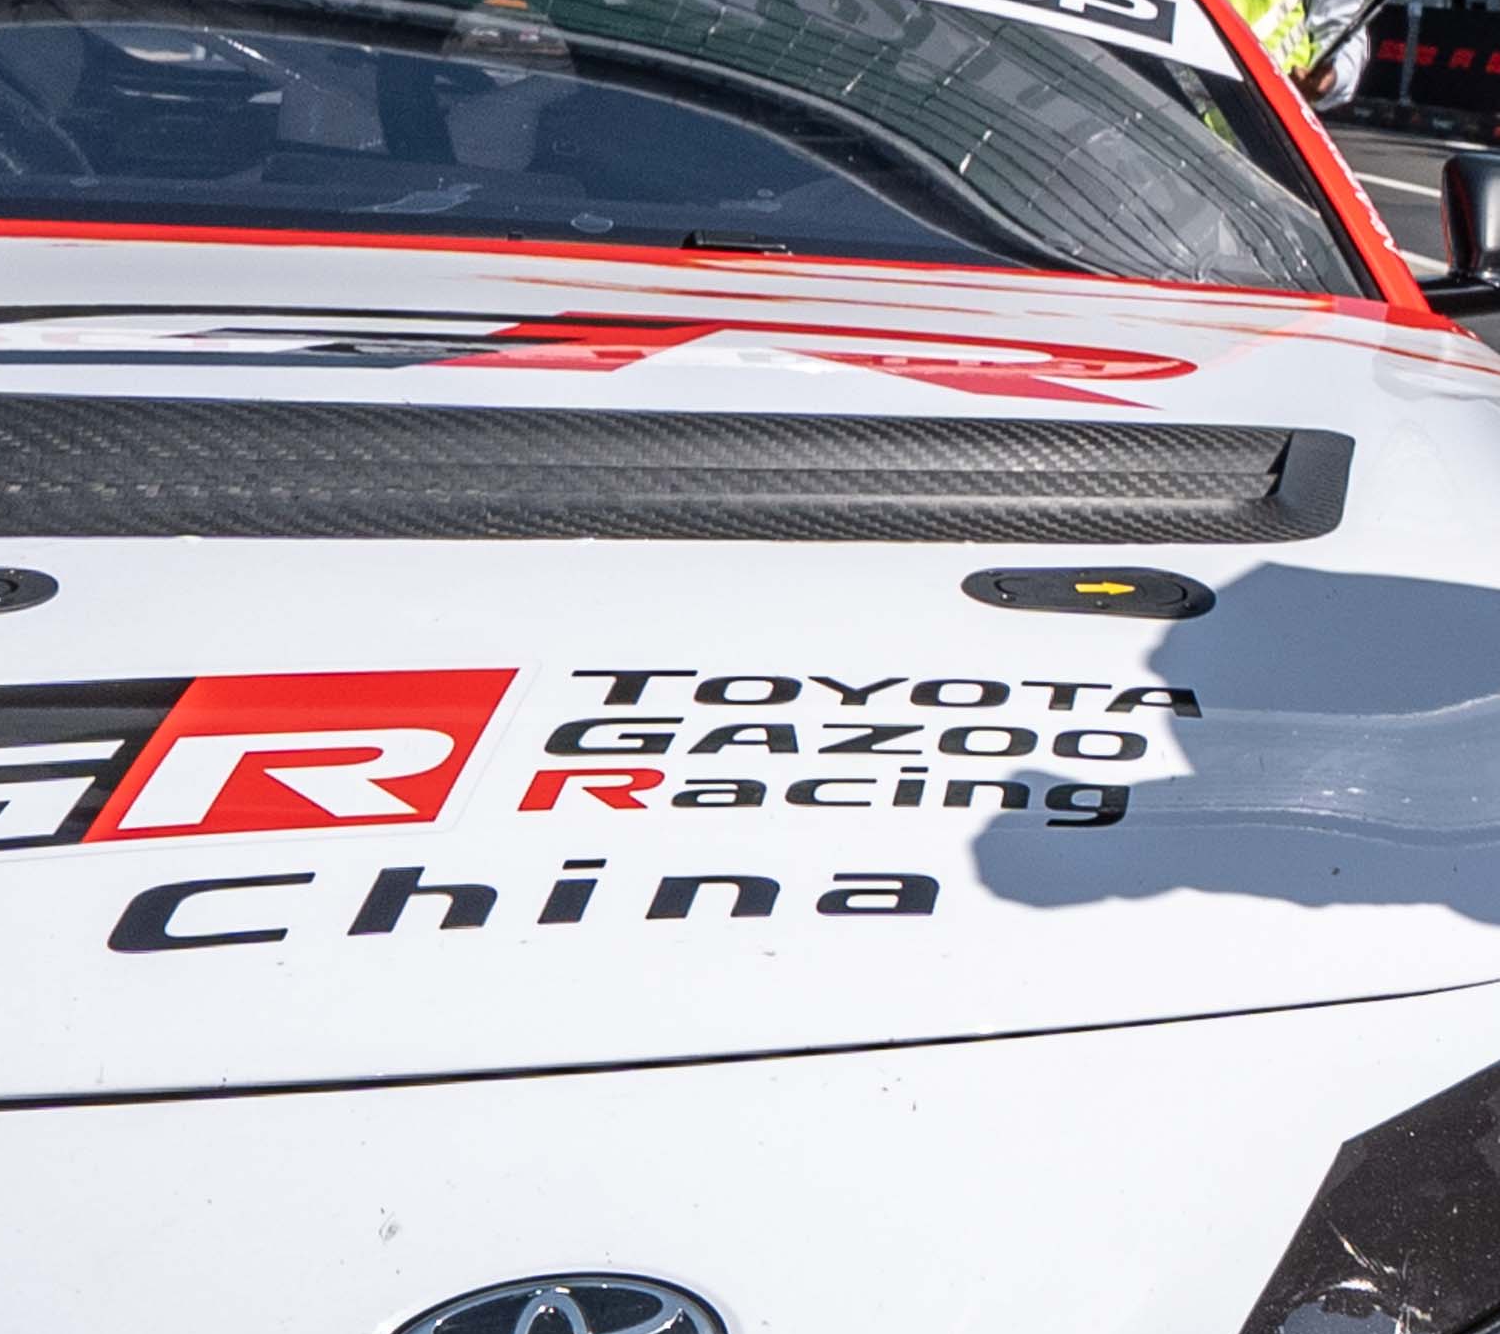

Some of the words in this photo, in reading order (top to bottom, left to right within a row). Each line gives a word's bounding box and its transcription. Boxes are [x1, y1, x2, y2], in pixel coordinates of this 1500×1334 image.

[571, 669, 1203, 719] TOYOTA
[543, 716, 1149, 762] GAZOO
[516, 766, 1131, 828] Racing
[107, 857, 941, 954] China
